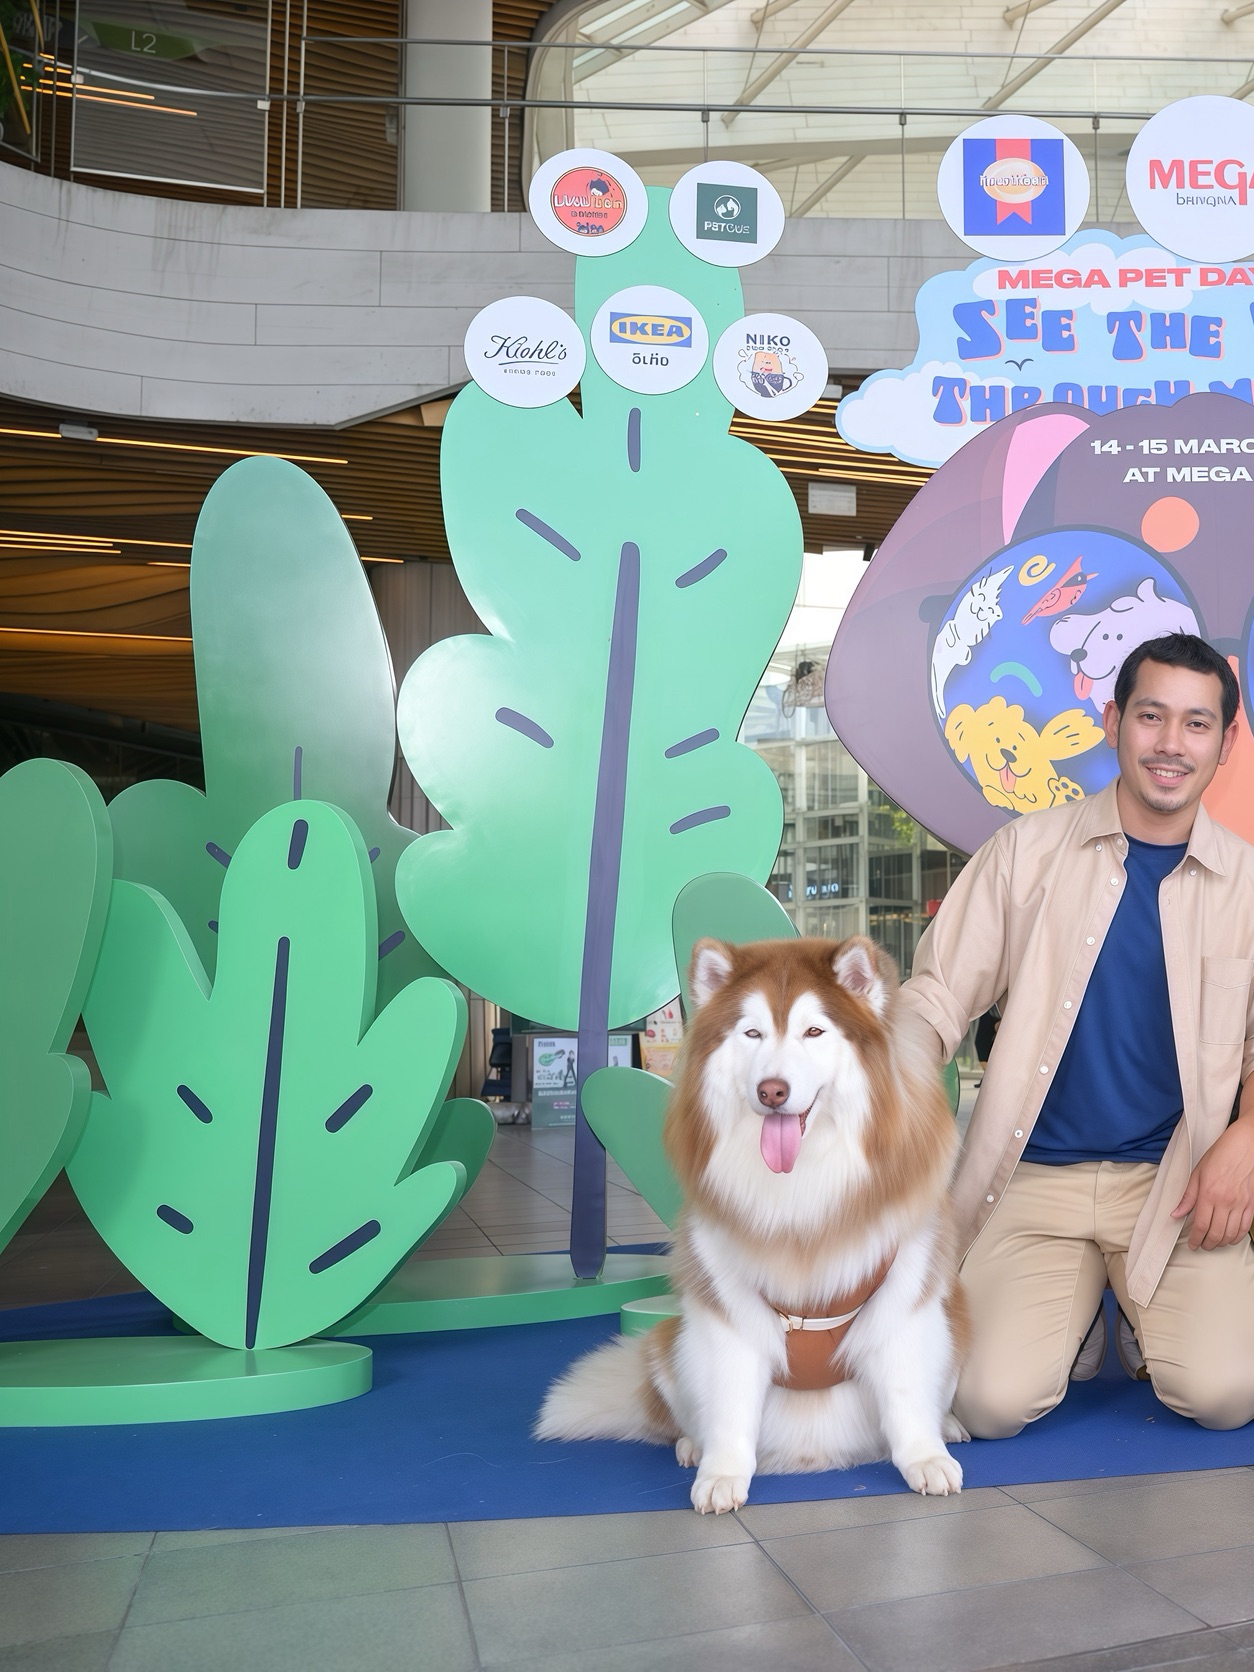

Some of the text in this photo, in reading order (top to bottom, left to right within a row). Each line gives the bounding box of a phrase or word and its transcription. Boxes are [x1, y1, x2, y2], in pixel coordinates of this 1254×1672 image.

[131, 31, 157, 54] L2
[998, 268, 1111, 290] MEGA
[1118, 267, 1191, 288] PET
[618, 321, 684, 338] IKEA
[952, 297, 1078, 361] SEE
[1107, 310, 1225, 362] THE
[746, 333, 791, 347] NIKO
[1090, 439, 1121, 455] 14
[1138, 439, 1168, 455] 15
[1123, 467, 1160, 483] AT
[1166, 466, 1253, 483] MEGA
